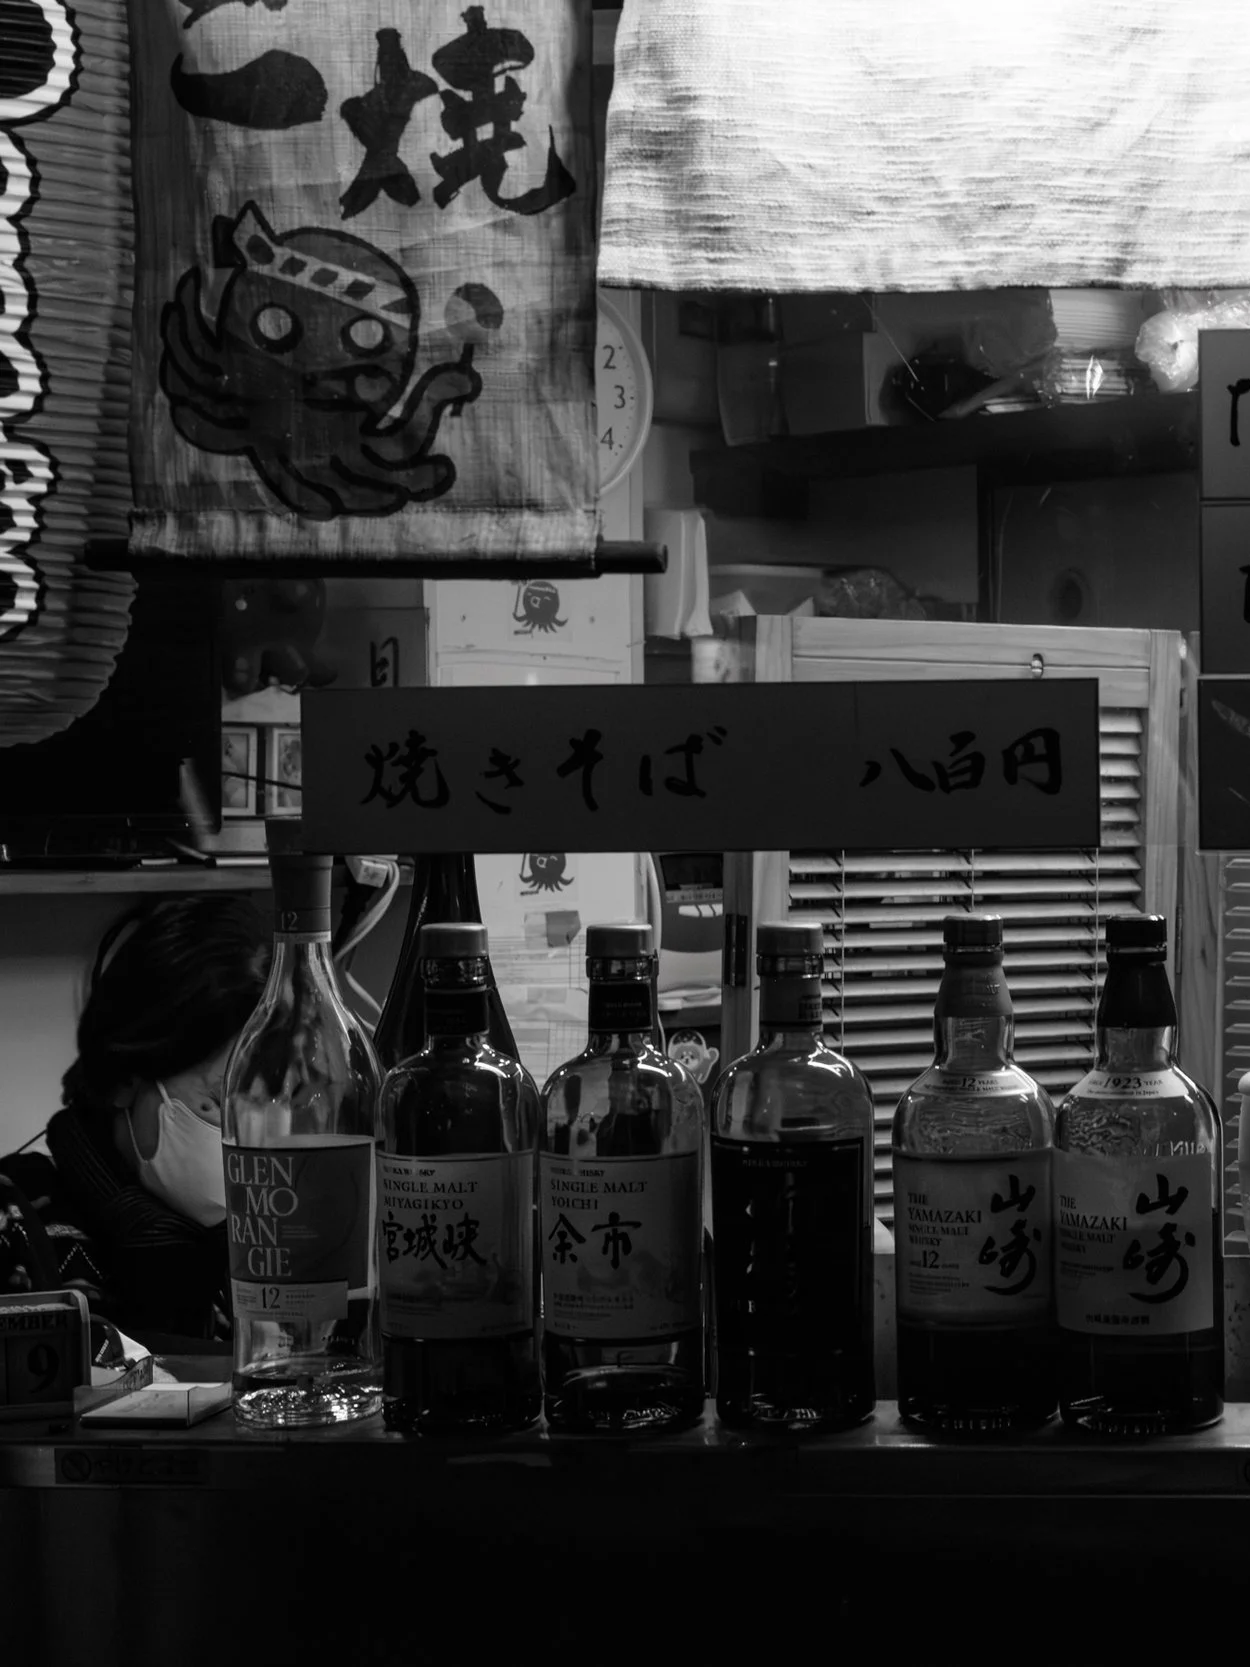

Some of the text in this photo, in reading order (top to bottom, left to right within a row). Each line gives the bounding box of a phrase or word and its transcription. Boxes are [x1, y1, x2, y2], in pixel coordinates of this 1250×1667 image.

[603, 345, 616, 370] 2
[614, 385, 625, 409] 3
[600, 427, 614, 450] 4
[360, 725, 1063, 815] 焼きそば 八百円
[280, 909, 299, 931] 12
[961, 1077, 976, 1087] 12
[227, 1152, 295, 1186] GLEN
[383, 1179, 478, 1194] SINGLE MALT
[550, 1178, 648, 1194] SINGLE MALT
[246, 1187, 299, 1217] MO
[383, 1196, 464, 1210] MIYAGIKYO
[551, 1195, 599, 1210] YOICHI
[908, 1191, 929, 1206] THE
[1059, 1194, 1077, 1210] THE
[908, 1206, 982, 1224] YAMAZAKI
[1059, 1209, 1128, 1232] YAMAZAKI
[230, 1215, 279, 1247] RAN
[548, 1211, 643, 1270] 余市
[247, 1246, 293, 1278] GIE
[921, 1249, 940, 1270] 12
[261, 1287, 281, 1310] 12
[27, 1343, 59, 1395] 9
